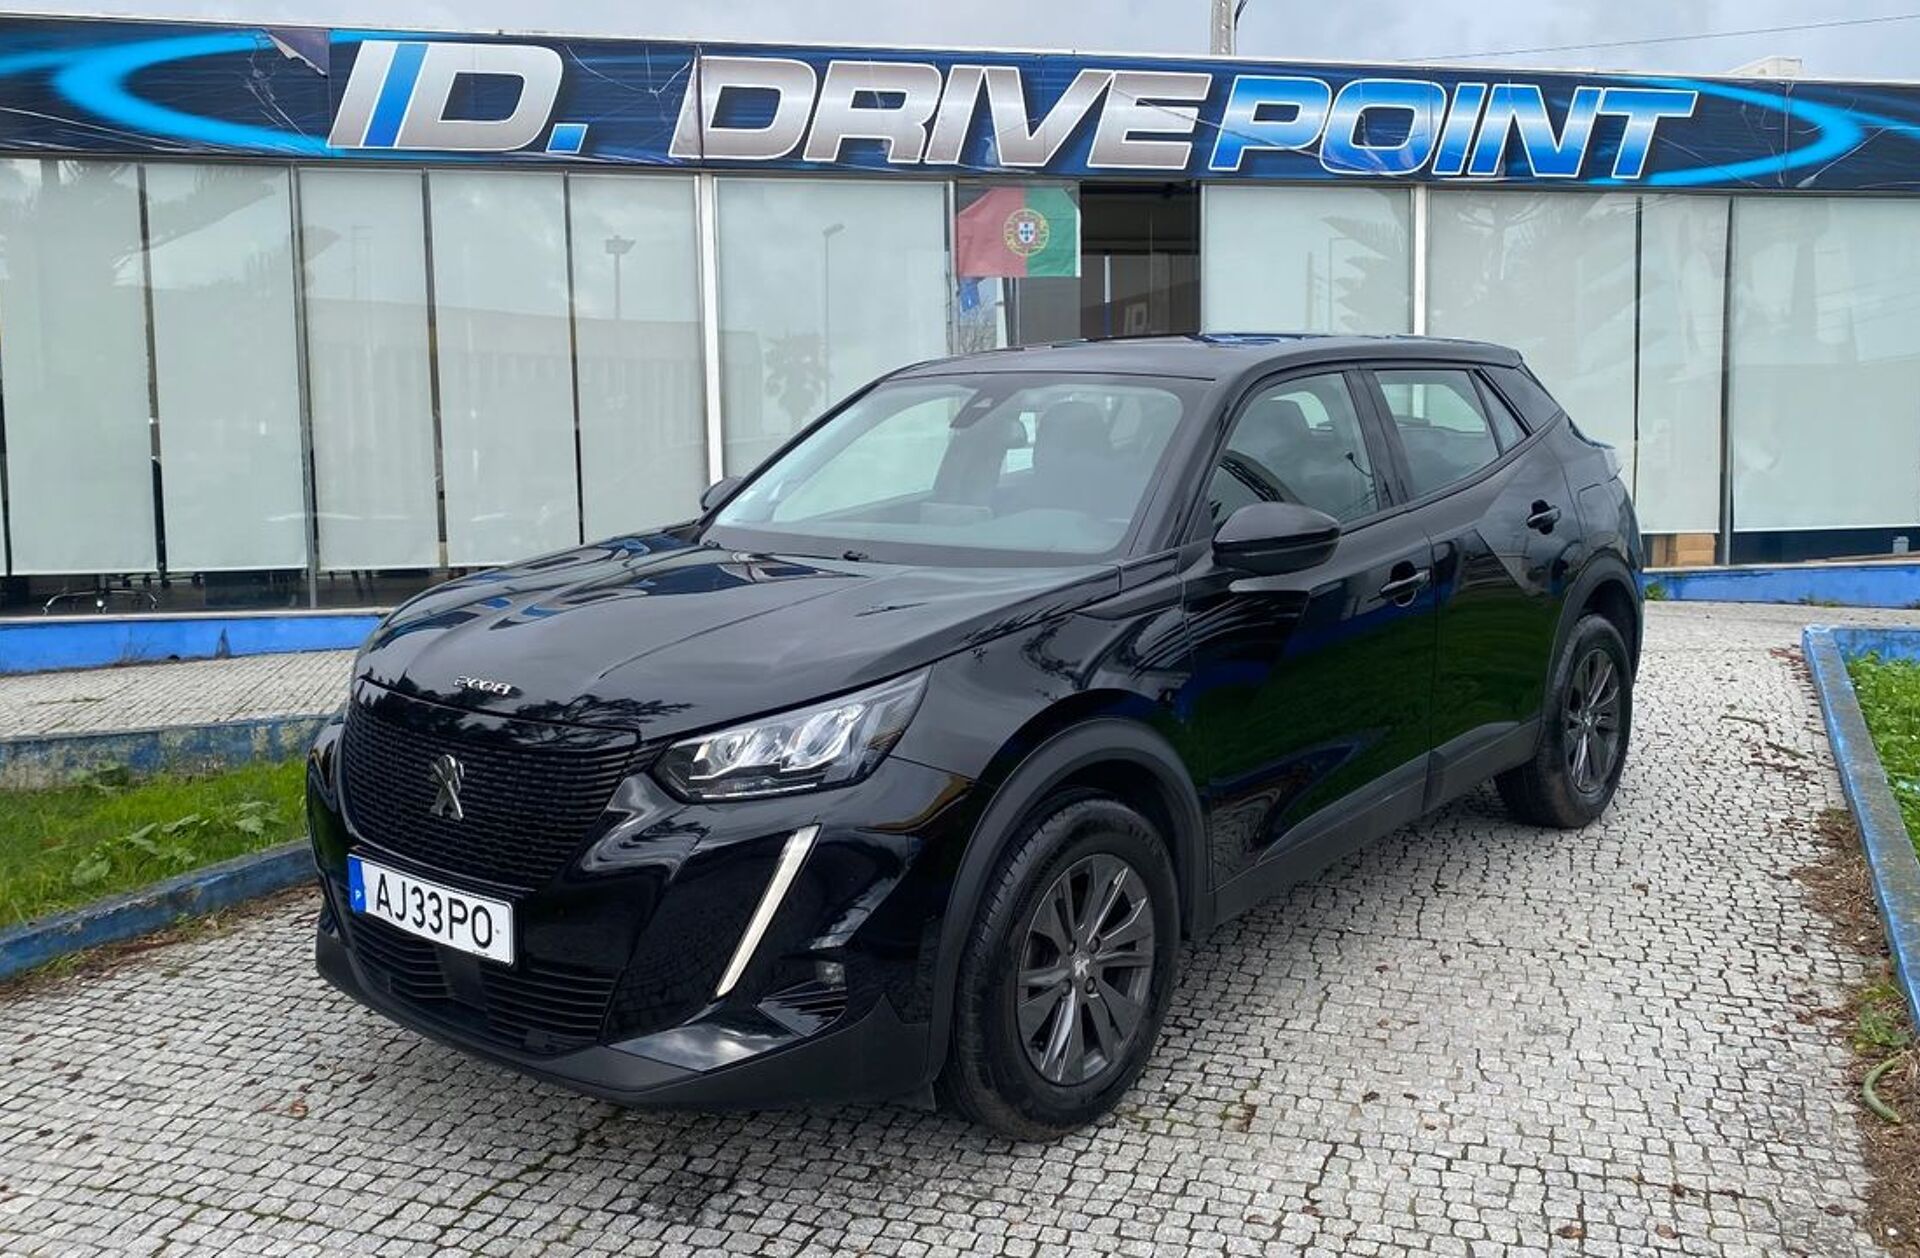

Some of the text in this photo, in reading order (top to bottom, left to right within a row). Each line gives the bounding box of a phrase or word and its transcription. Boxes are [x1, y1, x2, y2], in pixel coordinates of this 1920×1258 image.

[668, 55, 1213, 170] DRIVE
[1208, 75, 1699, 179] POINT
[376, 873, 493, 949] AJ33PO
